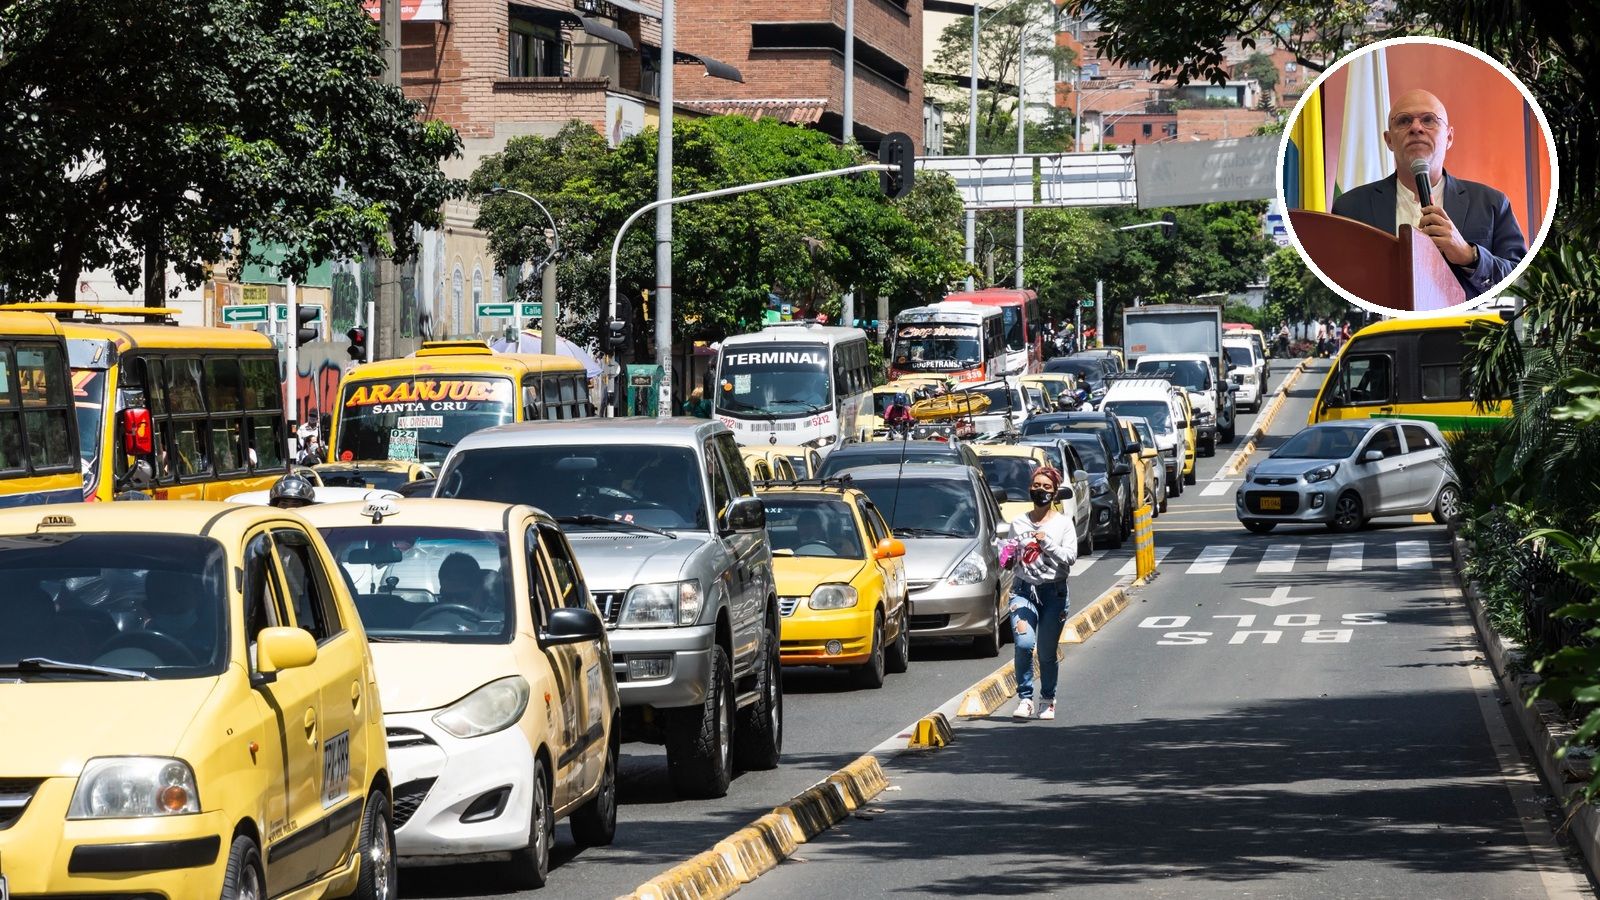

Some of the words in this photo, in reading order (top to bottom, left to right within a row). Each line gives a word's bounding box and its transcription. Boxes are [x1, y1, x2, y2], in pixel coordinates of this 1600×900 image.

[725, 352, 827, 366] TERMINAL
[372, 402, 426, 414] SANTA
[410, 416, 442, 427] ORIENTAL
[812, 415, 830, 427] 5212
[391, 430, 416, 438] 024
[47, 516, 67, 524] TAXI
[1138, 612, 1387, 628] SOLO
[1156, 629, 1354, 645] BUS
